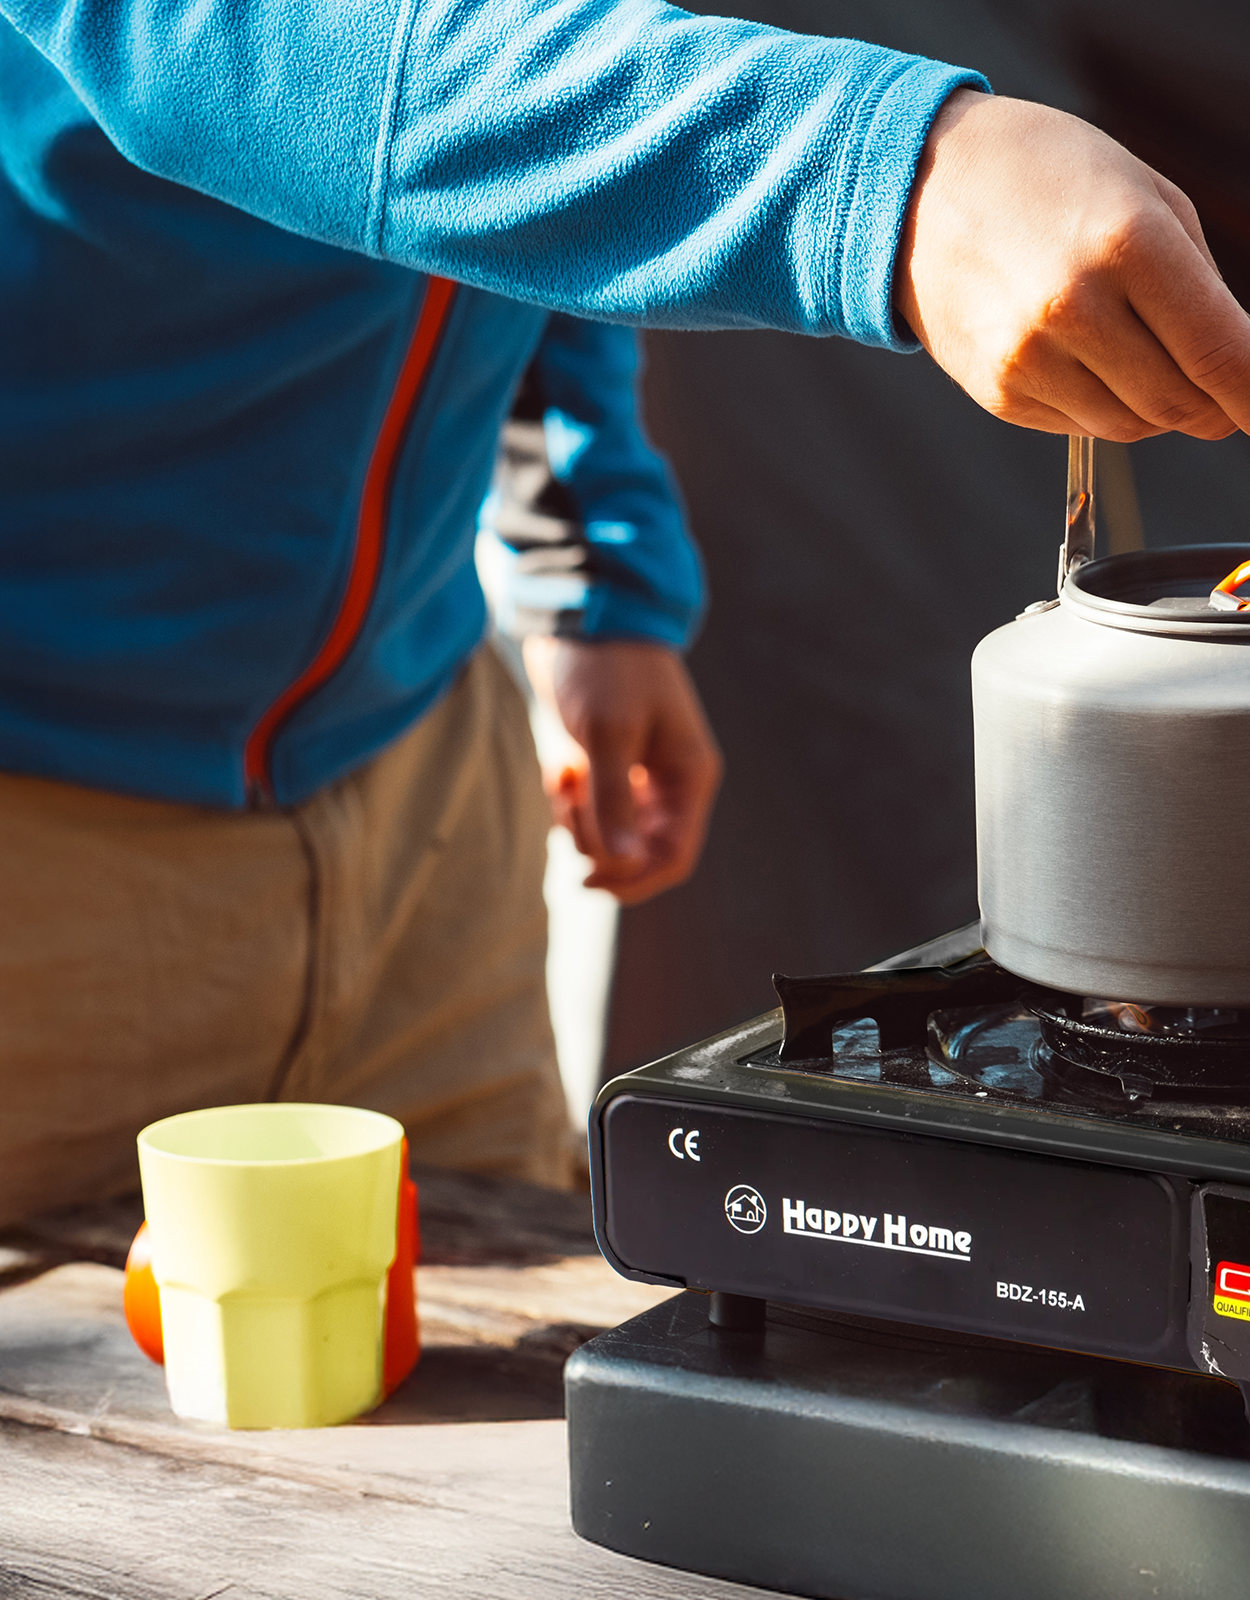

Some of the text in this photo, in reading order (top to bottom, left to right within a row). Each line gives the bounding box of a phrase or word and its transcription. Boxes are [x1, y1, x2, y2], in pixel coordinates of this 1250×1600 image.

[669, 1128, 700, 1161] CE
[783, 1198, 972, 1254] Happy Home
[996, 1281, 1086, 1312] BDZ-155-A
